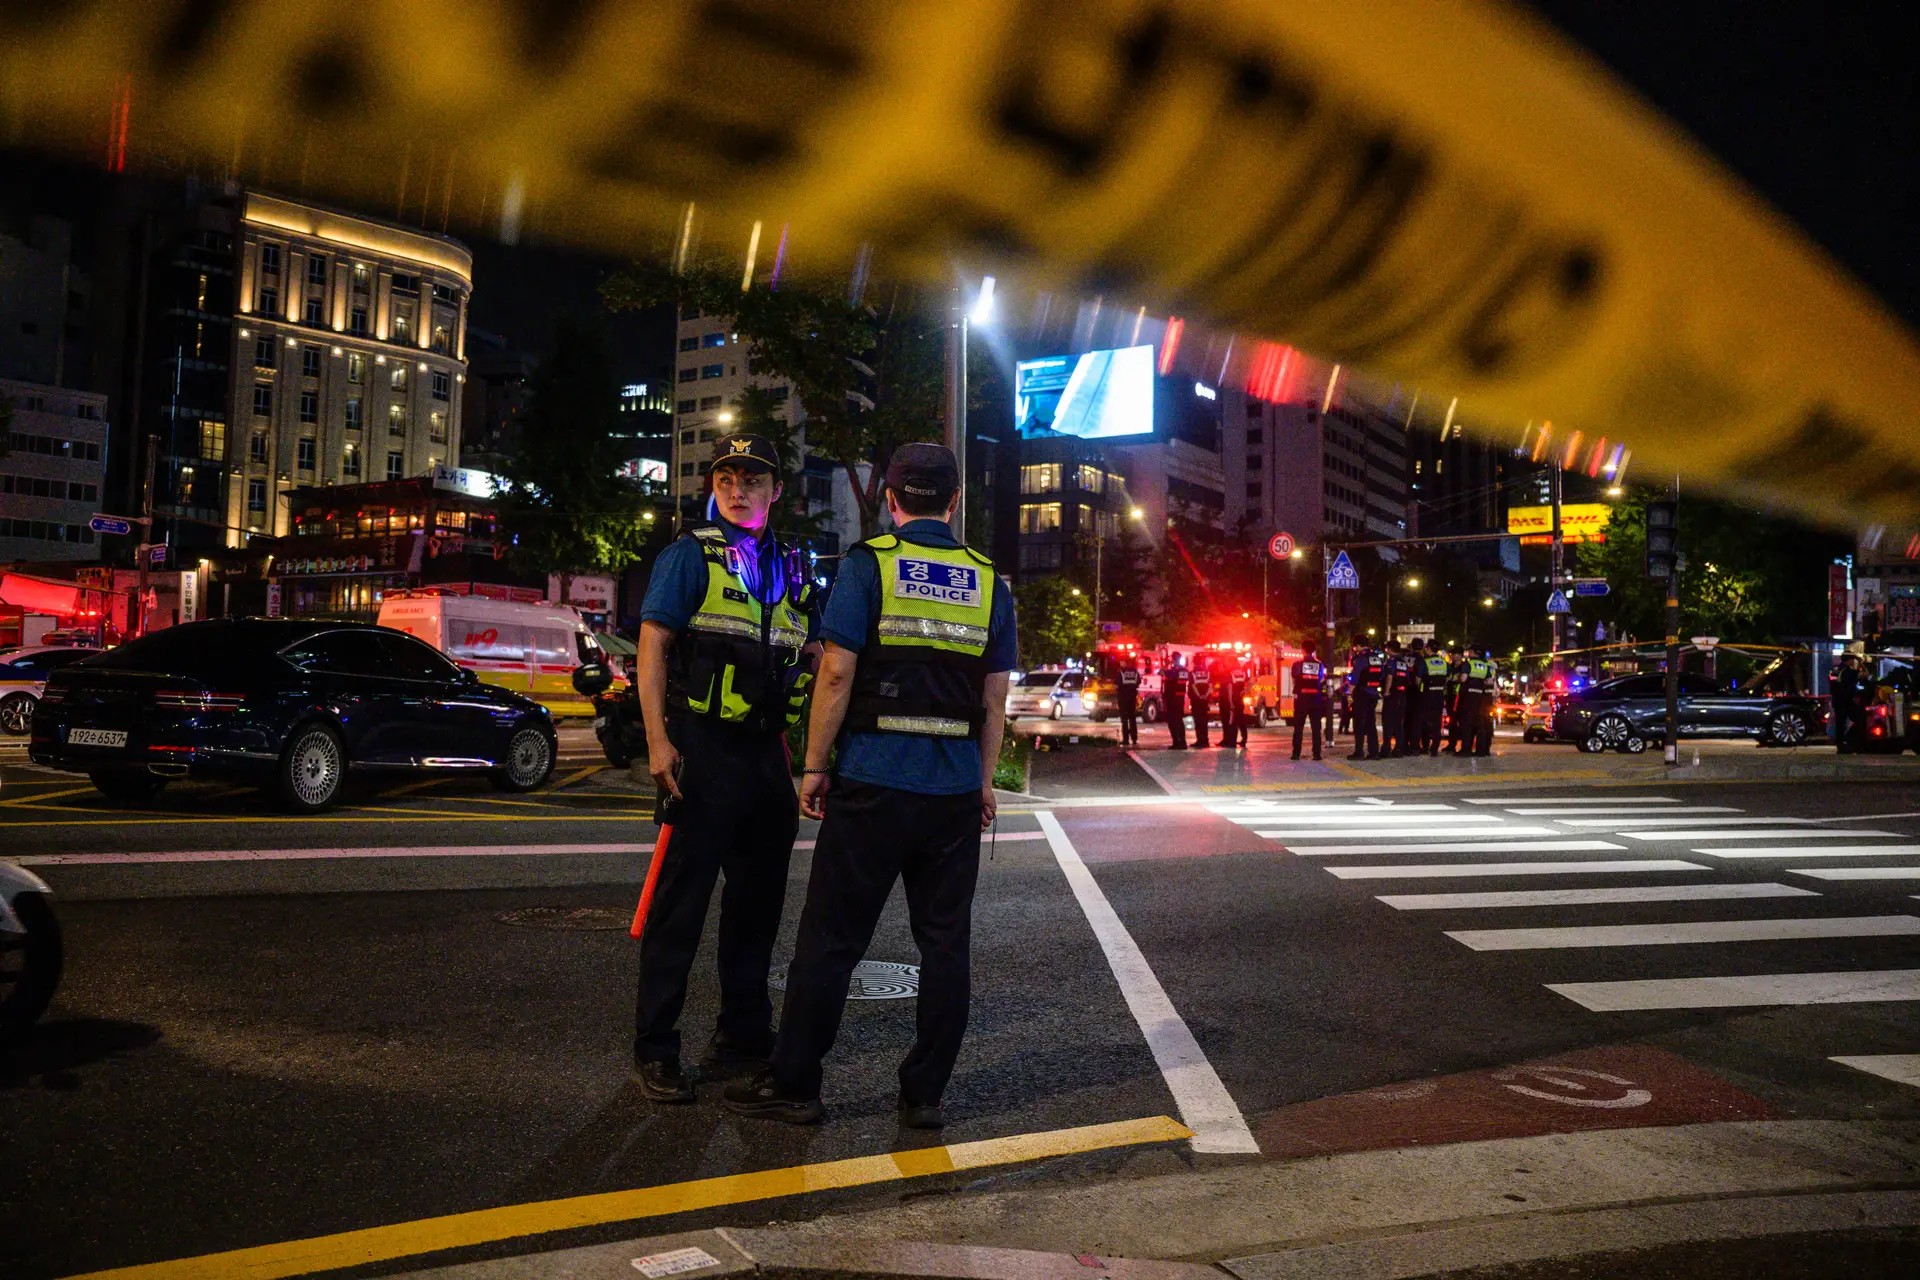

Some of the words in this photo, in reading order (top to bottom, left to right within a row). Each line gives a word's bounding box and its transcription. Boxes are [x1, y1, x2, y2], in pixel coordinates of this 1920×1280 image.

[1560, 515, 1601, 525] DHL
[1274, 539, 1290, 553] 50
[905, 583, 971, 602] POLICE
